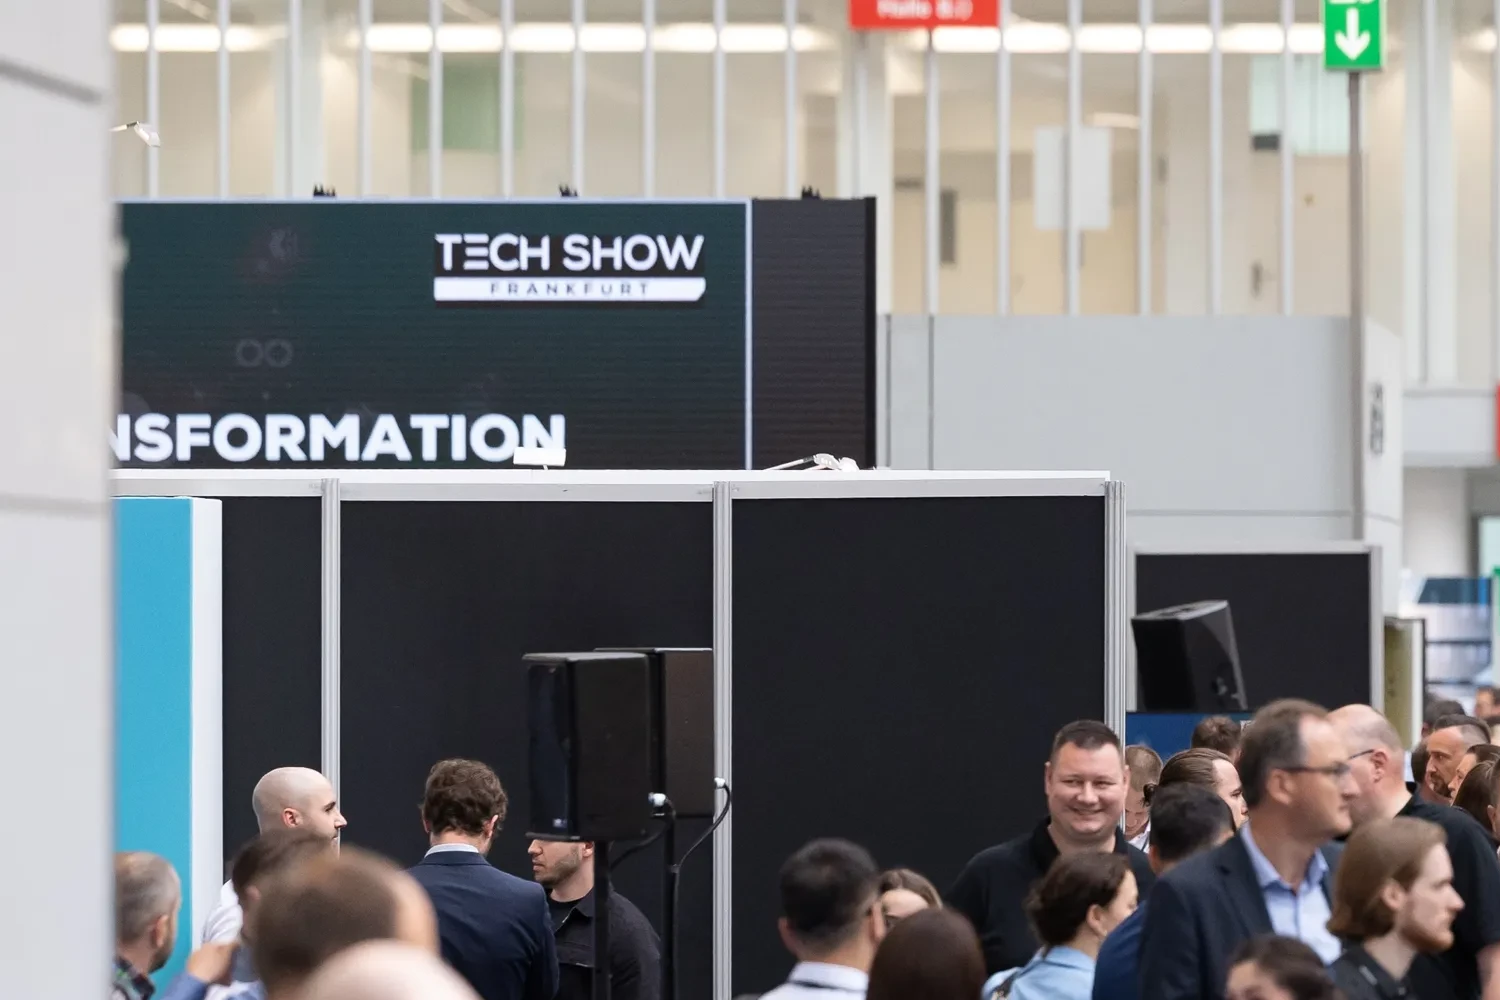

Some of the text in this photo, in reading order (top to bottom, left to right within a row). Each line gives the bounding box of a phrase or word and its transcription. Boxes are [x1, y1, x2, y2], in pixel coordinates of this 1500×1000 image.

[434, 233, 705, 271] TECH SHOW
[490, 282, 650, 297] FRANKFURT
